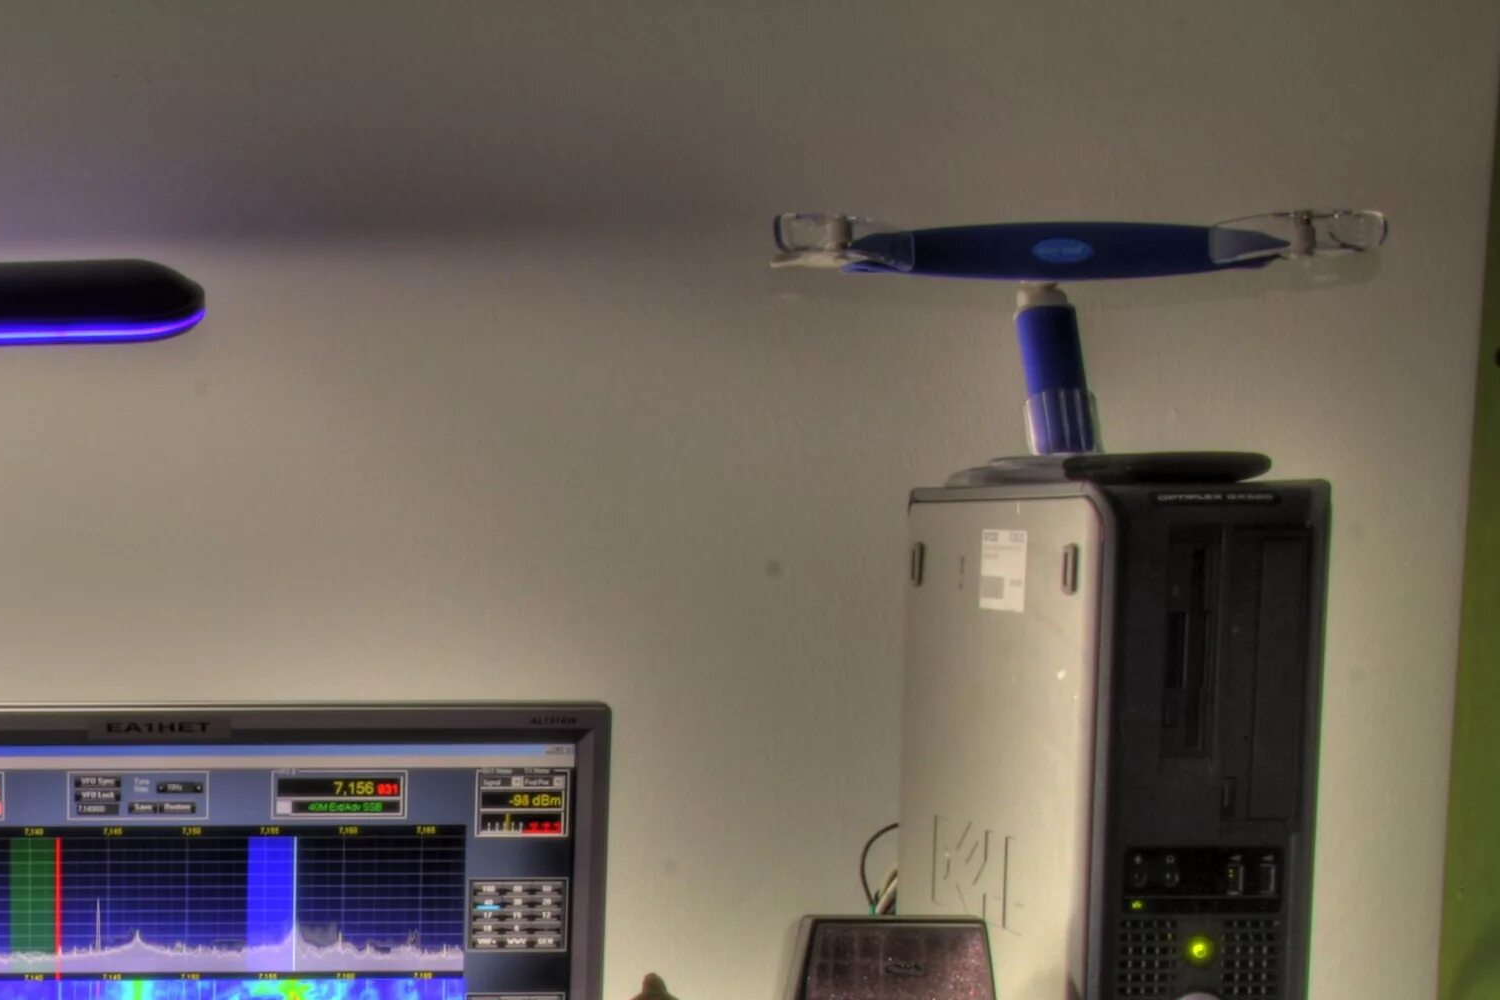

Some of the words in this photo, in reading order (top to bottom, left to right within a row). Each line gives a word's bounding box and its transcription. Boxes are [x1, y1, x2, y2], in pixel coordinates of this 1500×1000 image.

[106, 722, 210, 733] EA1HET
[334, 781, 374, 796] 7,156
[533, 790, 561, 806] dBm
[362, 802, 382, 812] SSB
